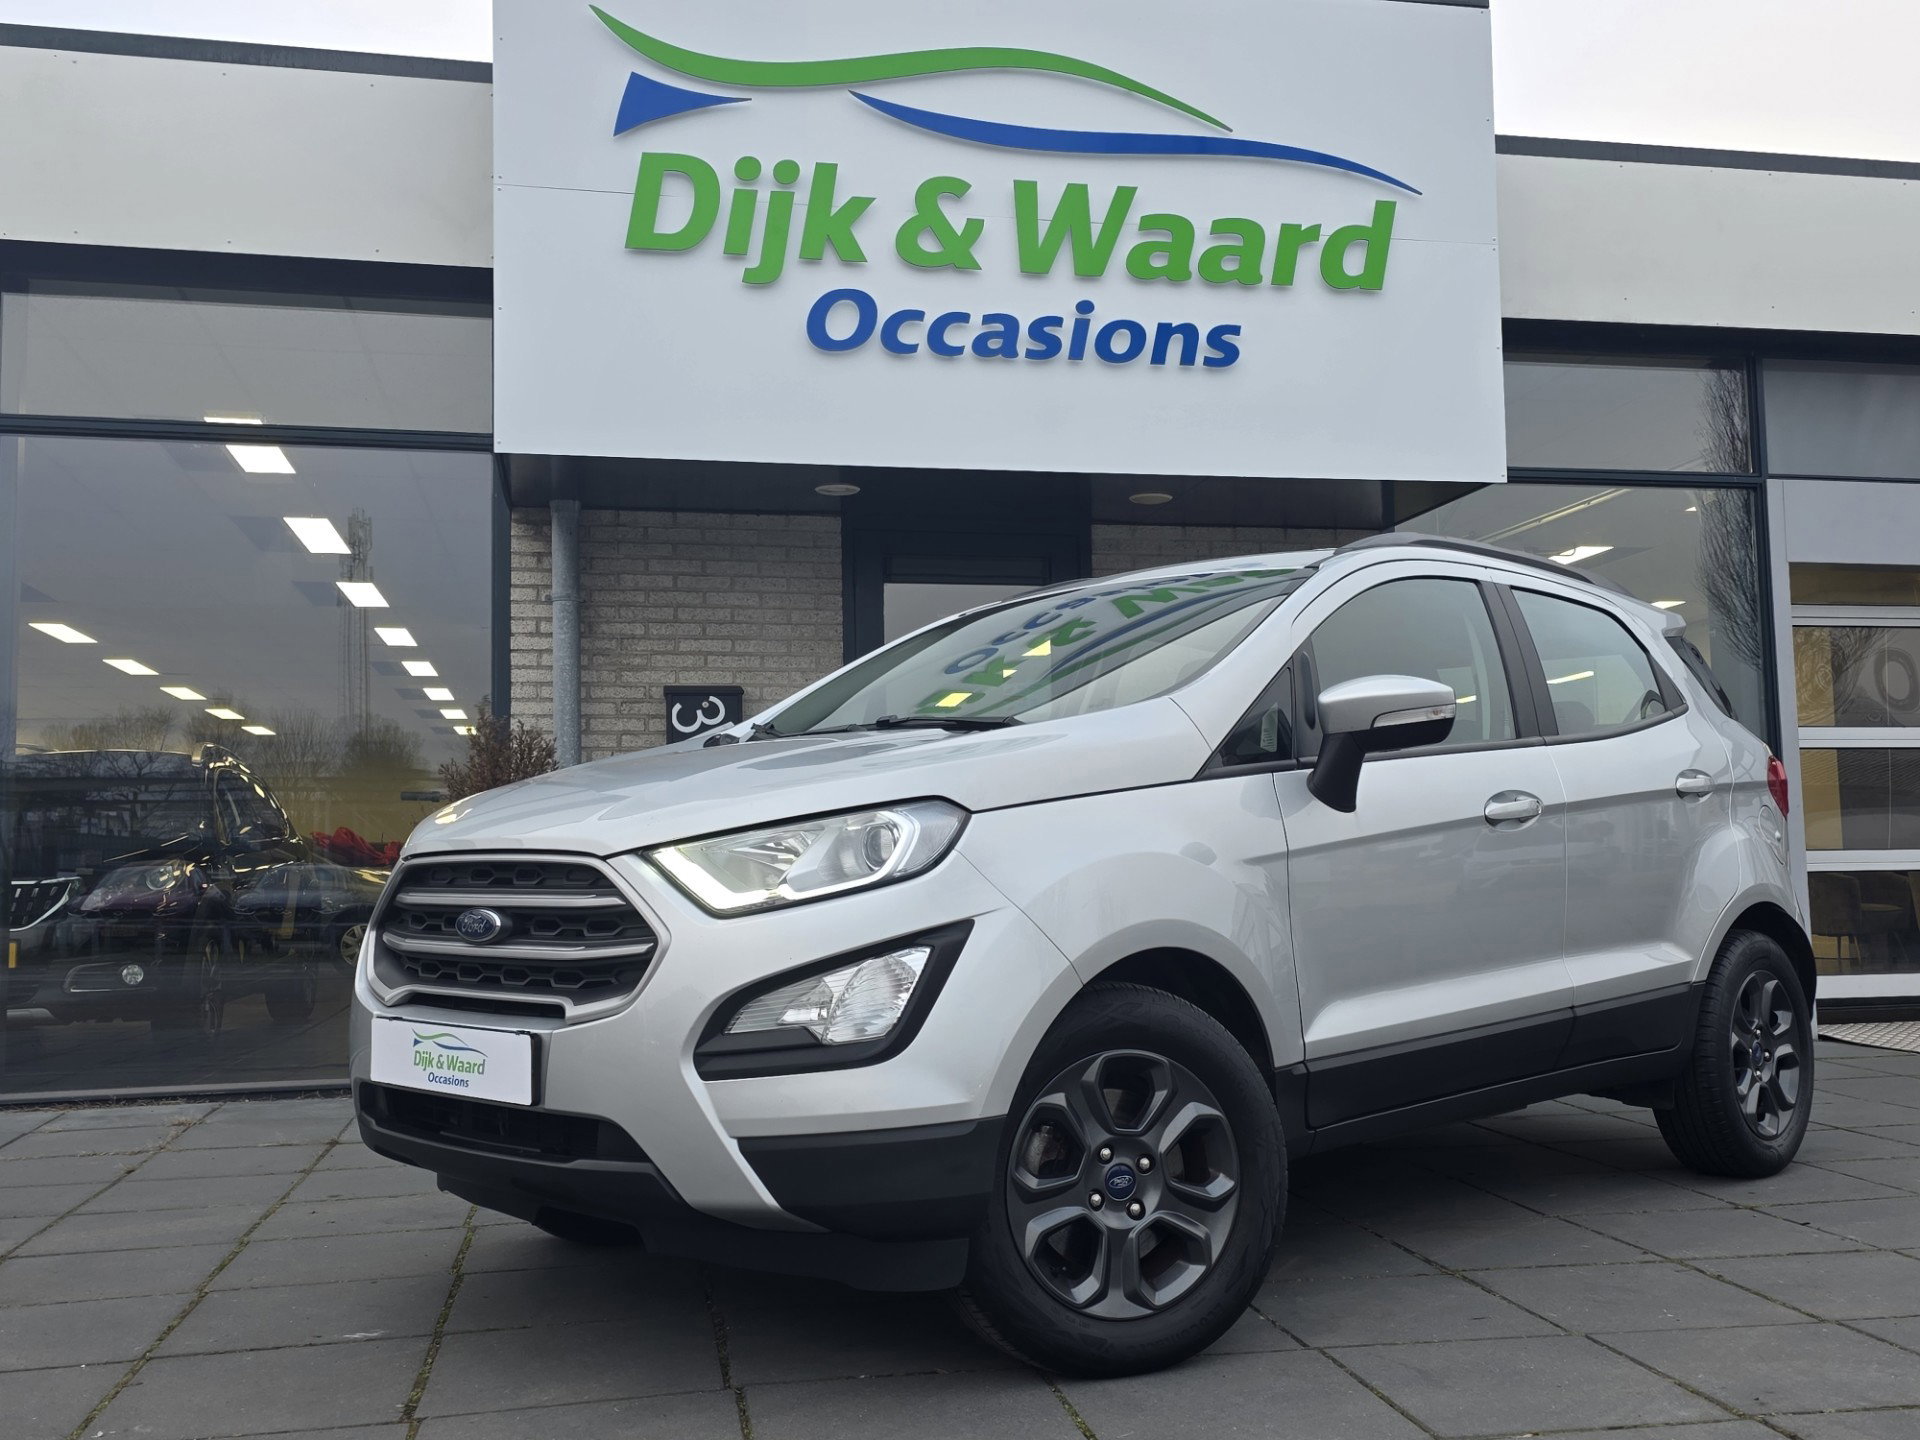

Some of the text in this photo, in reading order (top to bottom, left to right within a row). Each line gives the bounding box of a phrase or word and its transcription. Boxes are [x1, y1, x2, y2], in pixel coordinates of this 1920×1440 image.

[625, 151, 1397, 290] Dijk & Waard
[804, 287, 1243, 369] Occasions
[461, 914, 487, 933] Ford
[413, 1050, 486, 1075] Dijk & Waard
[427, 1071, 469, 1088] Occasions
